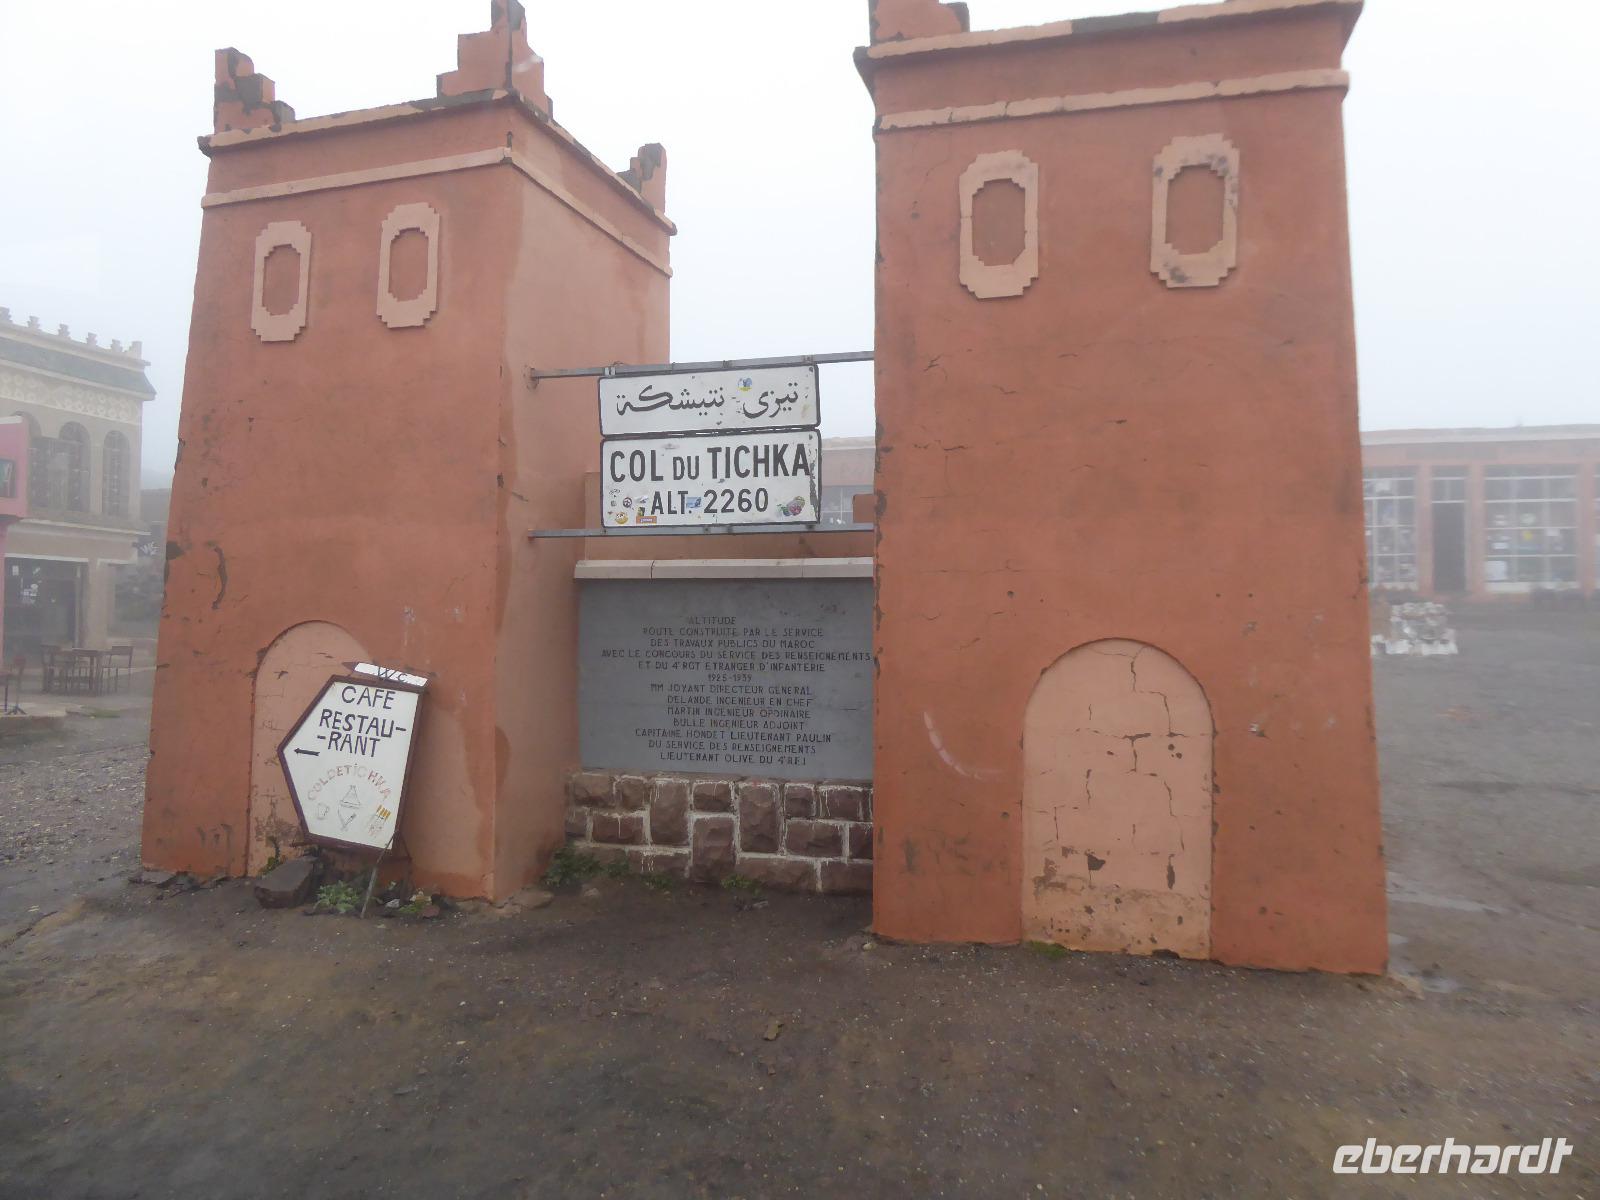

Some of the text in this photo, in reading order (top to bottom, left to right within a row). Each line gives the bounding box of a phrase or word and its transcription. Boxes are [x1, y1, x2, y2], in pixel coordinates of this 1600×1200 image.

[610, 443, 809, 482] COL DU TICHKA
[650, 487, 768, 514] ALT. 2260
[687, 616, 737, 625] ALTITUDE
[680, 627, 738, 637] CONSTRUITE
[743, 627, 761, 637] PAR
[766, 628, 778, 637] LE
[783, 627, 824, 637] SERVICE
[649, 639, 815, 649] DES TRAVAUX PUBLICS DU MAROC
[601, 649, 625, 658] AVEC
[628, 649, 641, 658] LE
[645, 649, 696, 659] CONCOURS
[700, 650, 713, 659] DU
[718, 650, 756, 660] SERVICE
[761, 650, 781, 660] DES
[638, 660, 651, 669] ET
[655, 660, 668, 670] DU
[705, 661, 755, 671] ETRANGER
[669, 683, 706, 692] JOYANT
[709, 684, 764, 694] DIRECTEUR
[768, 685, 812, 696] GENERAL
[341, 685, 397, 710] CAFE
[769, 697, 782, 706] EN
[786, 698, 814, 707] CHEF
[667, 707, 701, 716] MARTIN
[705, 708, 755, 717] INGENIEUR
[319, 708, 408, 739] RESTAU-
[673, 717, 805, 731] BULLE INGENIEUR ADJOINT
[635, 728, 682, 738] CAPITAINE
[730, 731, 791, 742] LIEUTENANT
[796, 733, 832, 743] PAULIN
[317, 731, 382, 759] -RANT
[648, 740, 662, 749] DU
[666, 740, 705, 750] SERVICE
[709, 741, 728, 751] DES
[660, 752, 720, 763] LIEUTENANT
[724, 754, 755, 764] OLIVE
[759, 756, 774, 765] DU
